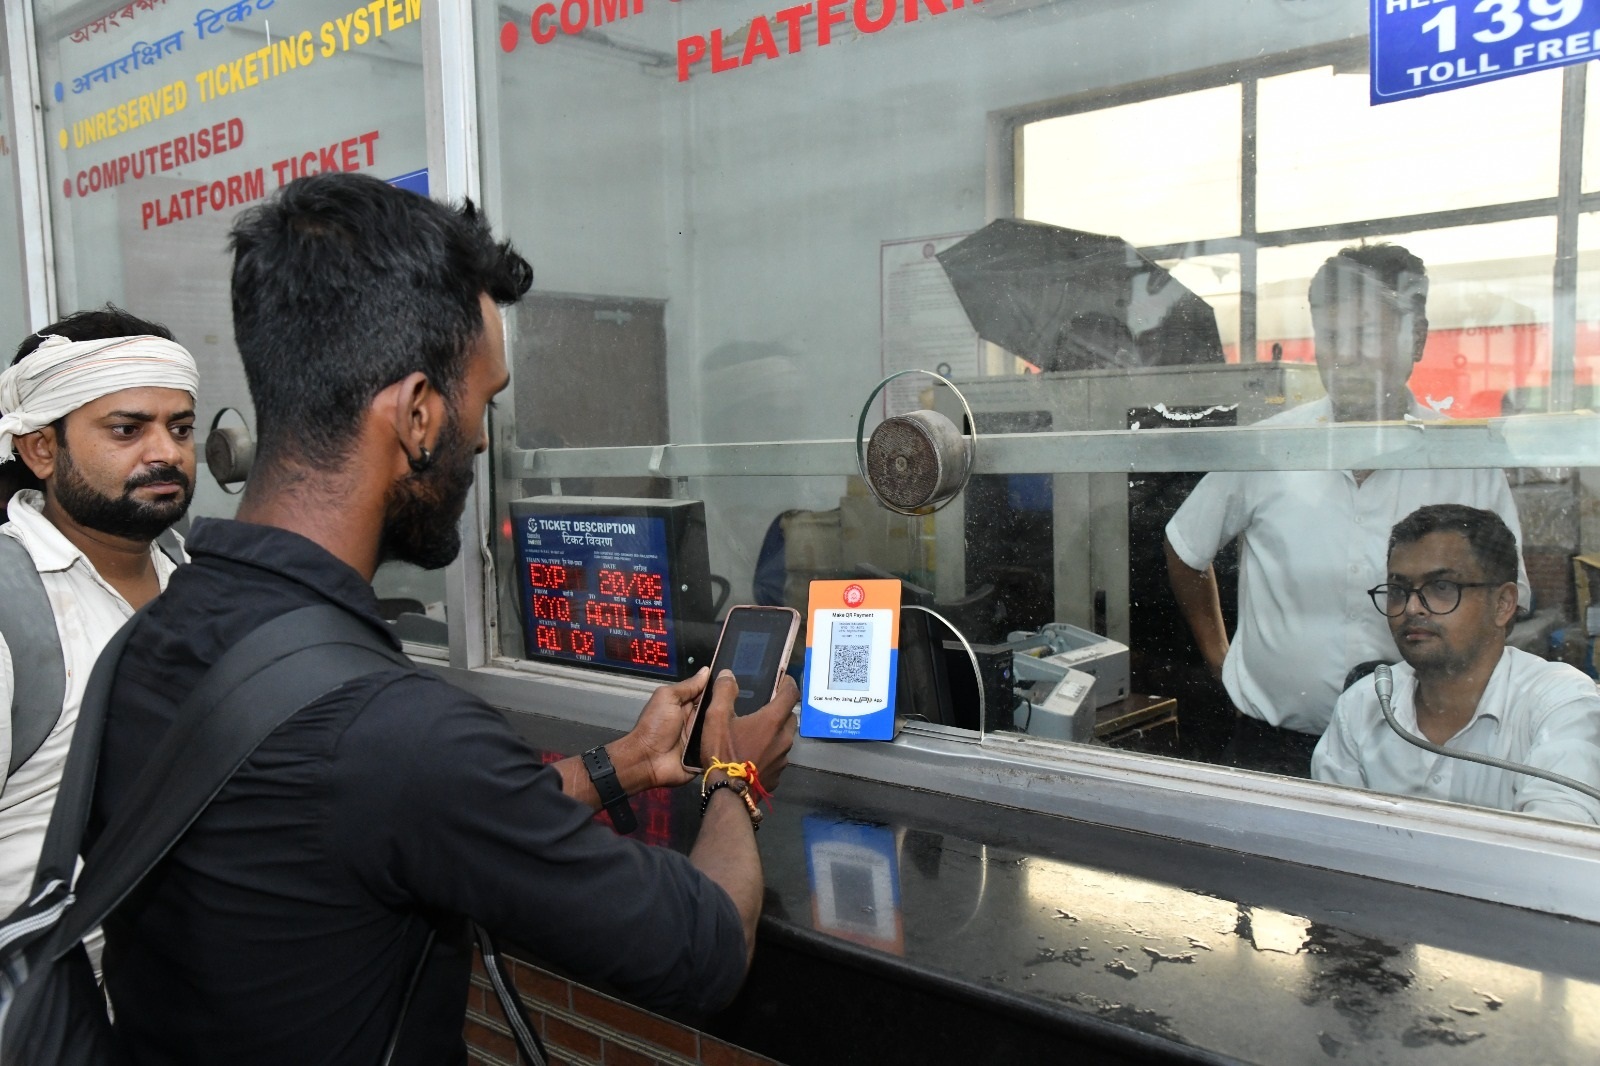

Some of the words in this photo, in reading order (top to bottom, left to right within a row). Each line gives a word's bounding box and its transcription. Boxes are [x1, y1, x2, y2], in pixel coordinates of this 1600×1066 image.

[531, 0, 683, 45] COM
[677, 0, 984, 82] PLATFO
[1422, 0, 1583, 53] 139
[72, 30, 184, 94] अनारक्षित
[1406, 53, 1500, 86] TOLL
[73, 79, 188, 149] UNRESERVED
[195, 30, 314, 103] TICKETING
[77, 117, 244, 198] COMPUTERISED
[142, 168, 265, 230] PLATFORM
[272, 130, 379, 188] TICKET
[539, 519, 571, 531] TICKET
[573, 521, 636, 535] DESCRIPTION
[562, 531, 584, 546] टिकट
[585, 532, 613, 548] विवरण
[530, 563, 567, 589] EXP
[585, 600, 635, 630] AGTL
[830, 717, 862, 730] CRIS
